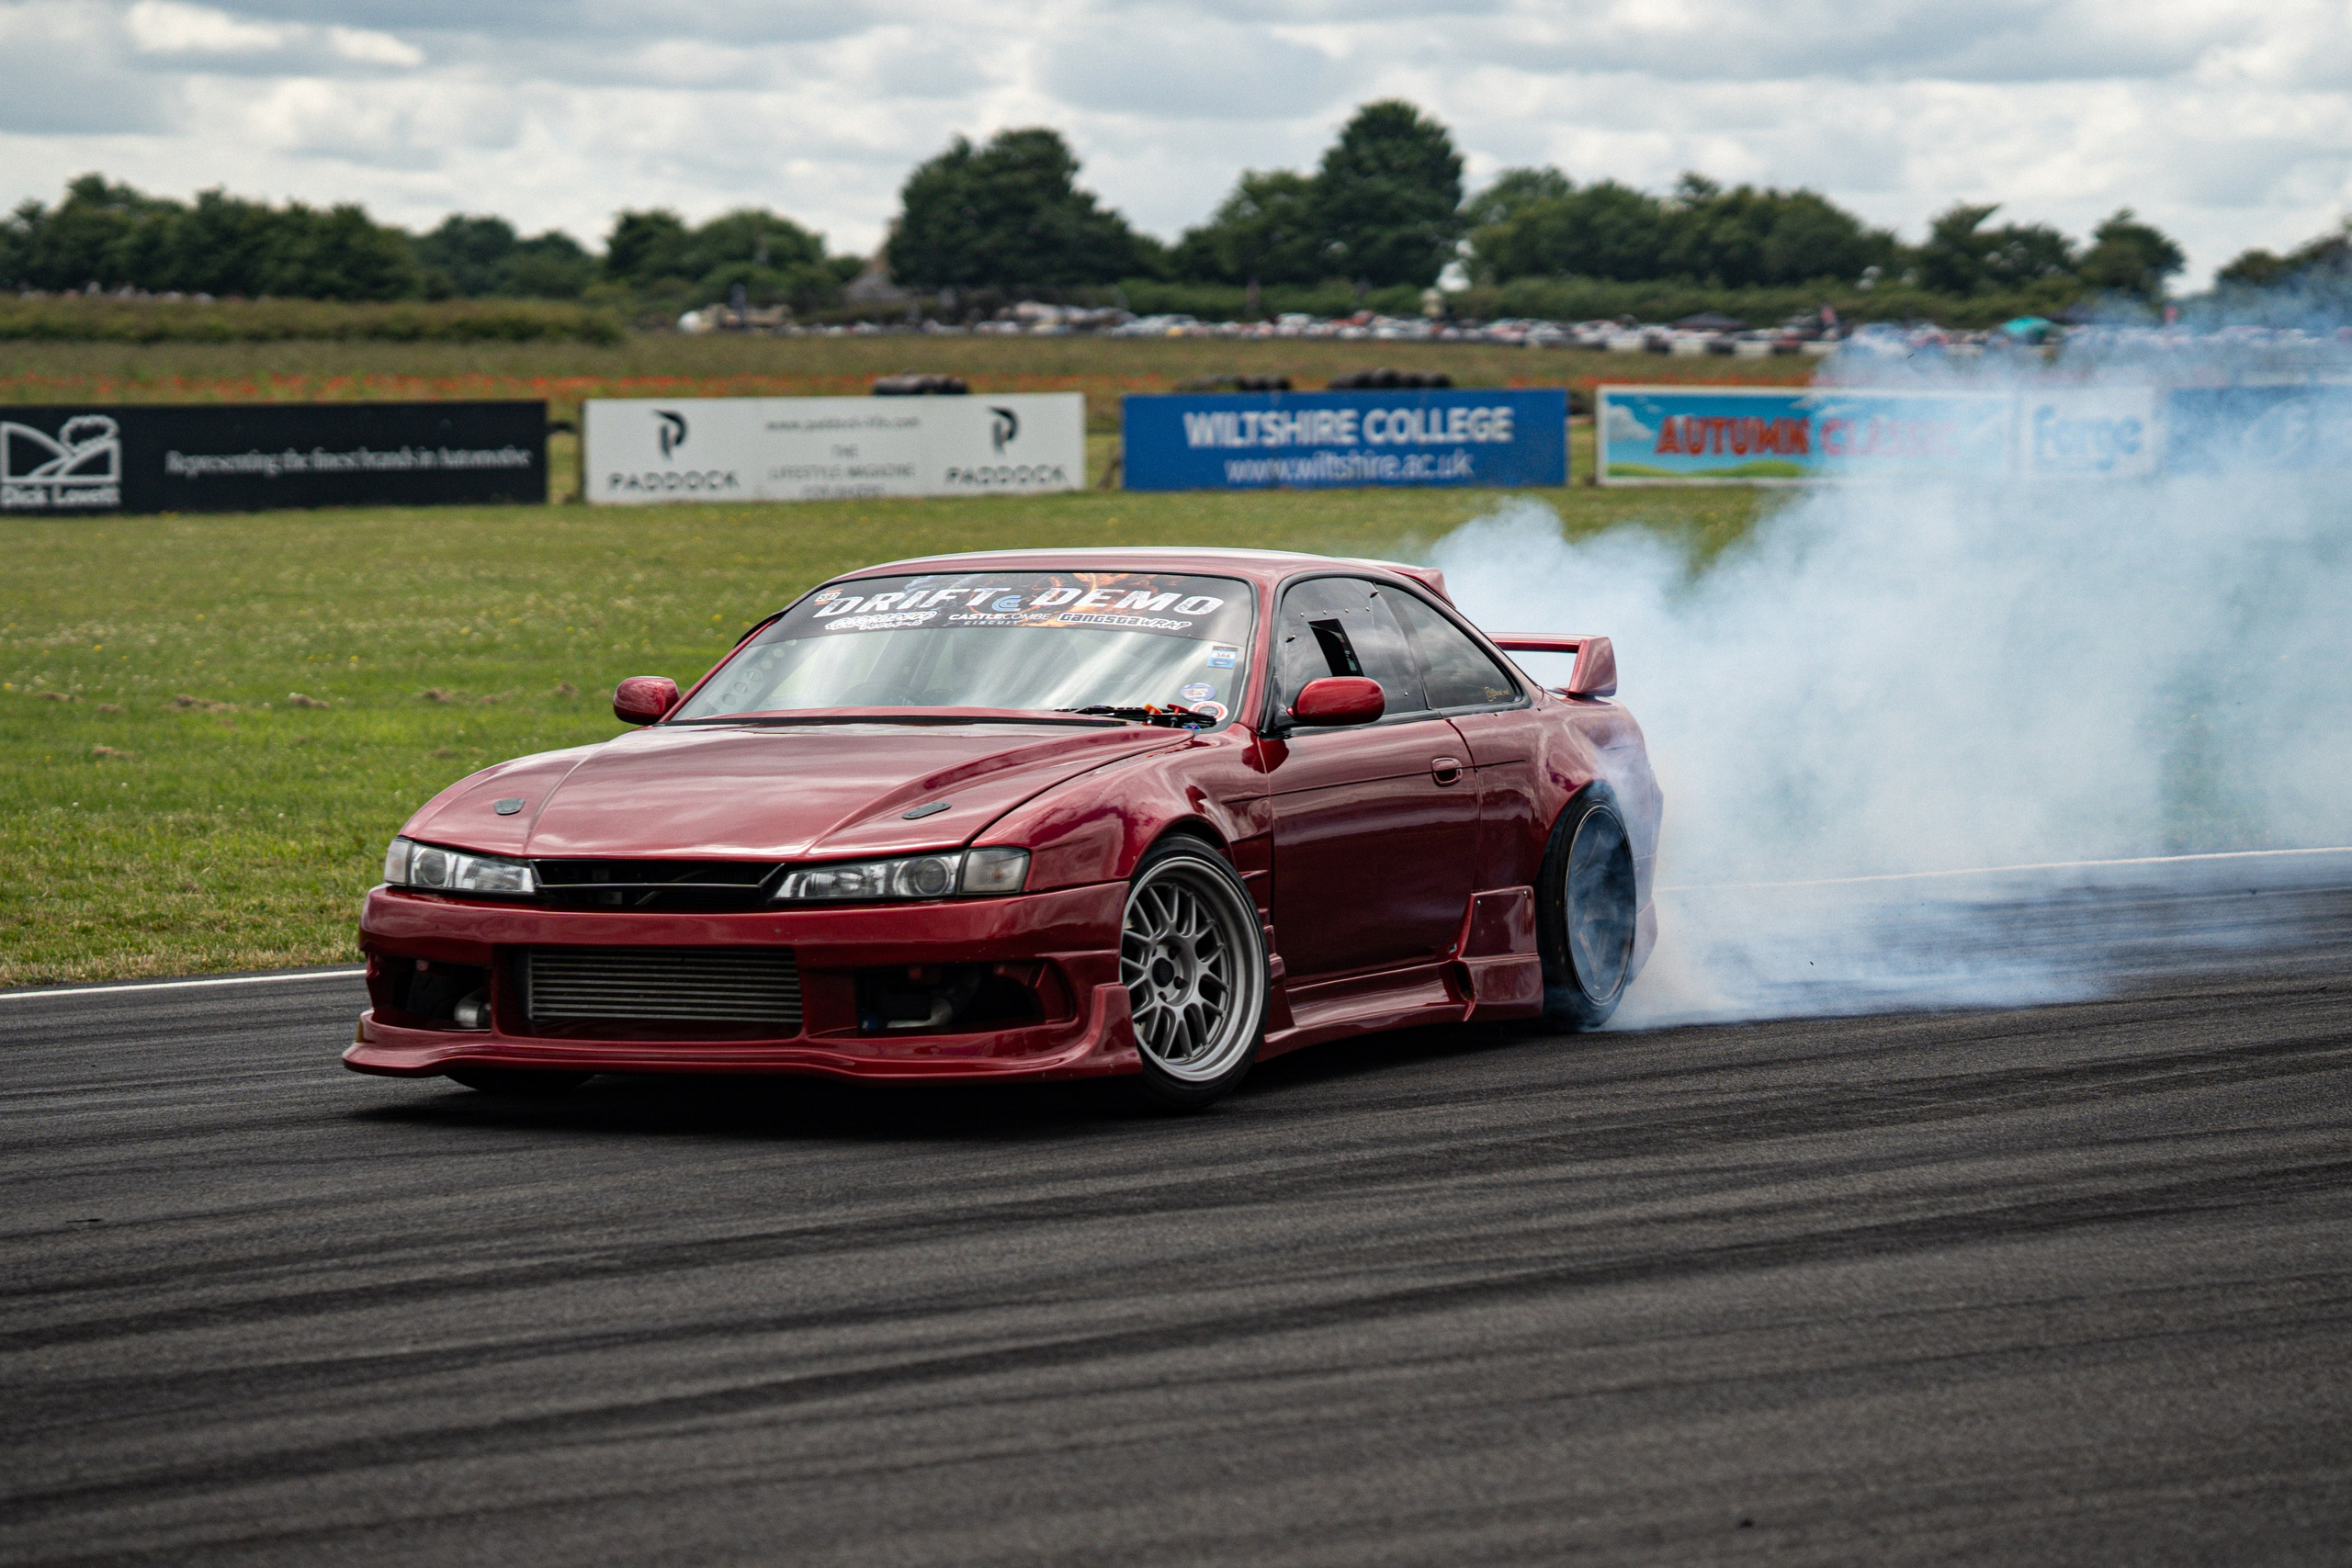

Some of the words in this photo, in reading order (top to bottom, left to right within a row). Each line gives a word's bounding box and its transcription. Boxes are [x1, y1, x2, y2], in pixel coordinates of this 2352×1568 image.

[1182, 410, 1360, 448] WILTSHIRE
[1362, 406, 1515, 445] COLLEGE
[1656, 415, 1813, 456] AUTUMN
[607, 468, 740, 491] PADDOCK
[944, 463, 1068, 486] PADDOCK
[1224, 447, 1475, 482] www.wiltshire.ac.uk
[812, 587, 1012, 617] DRIFT
[1029, 587, 1225, 615] DEMO
